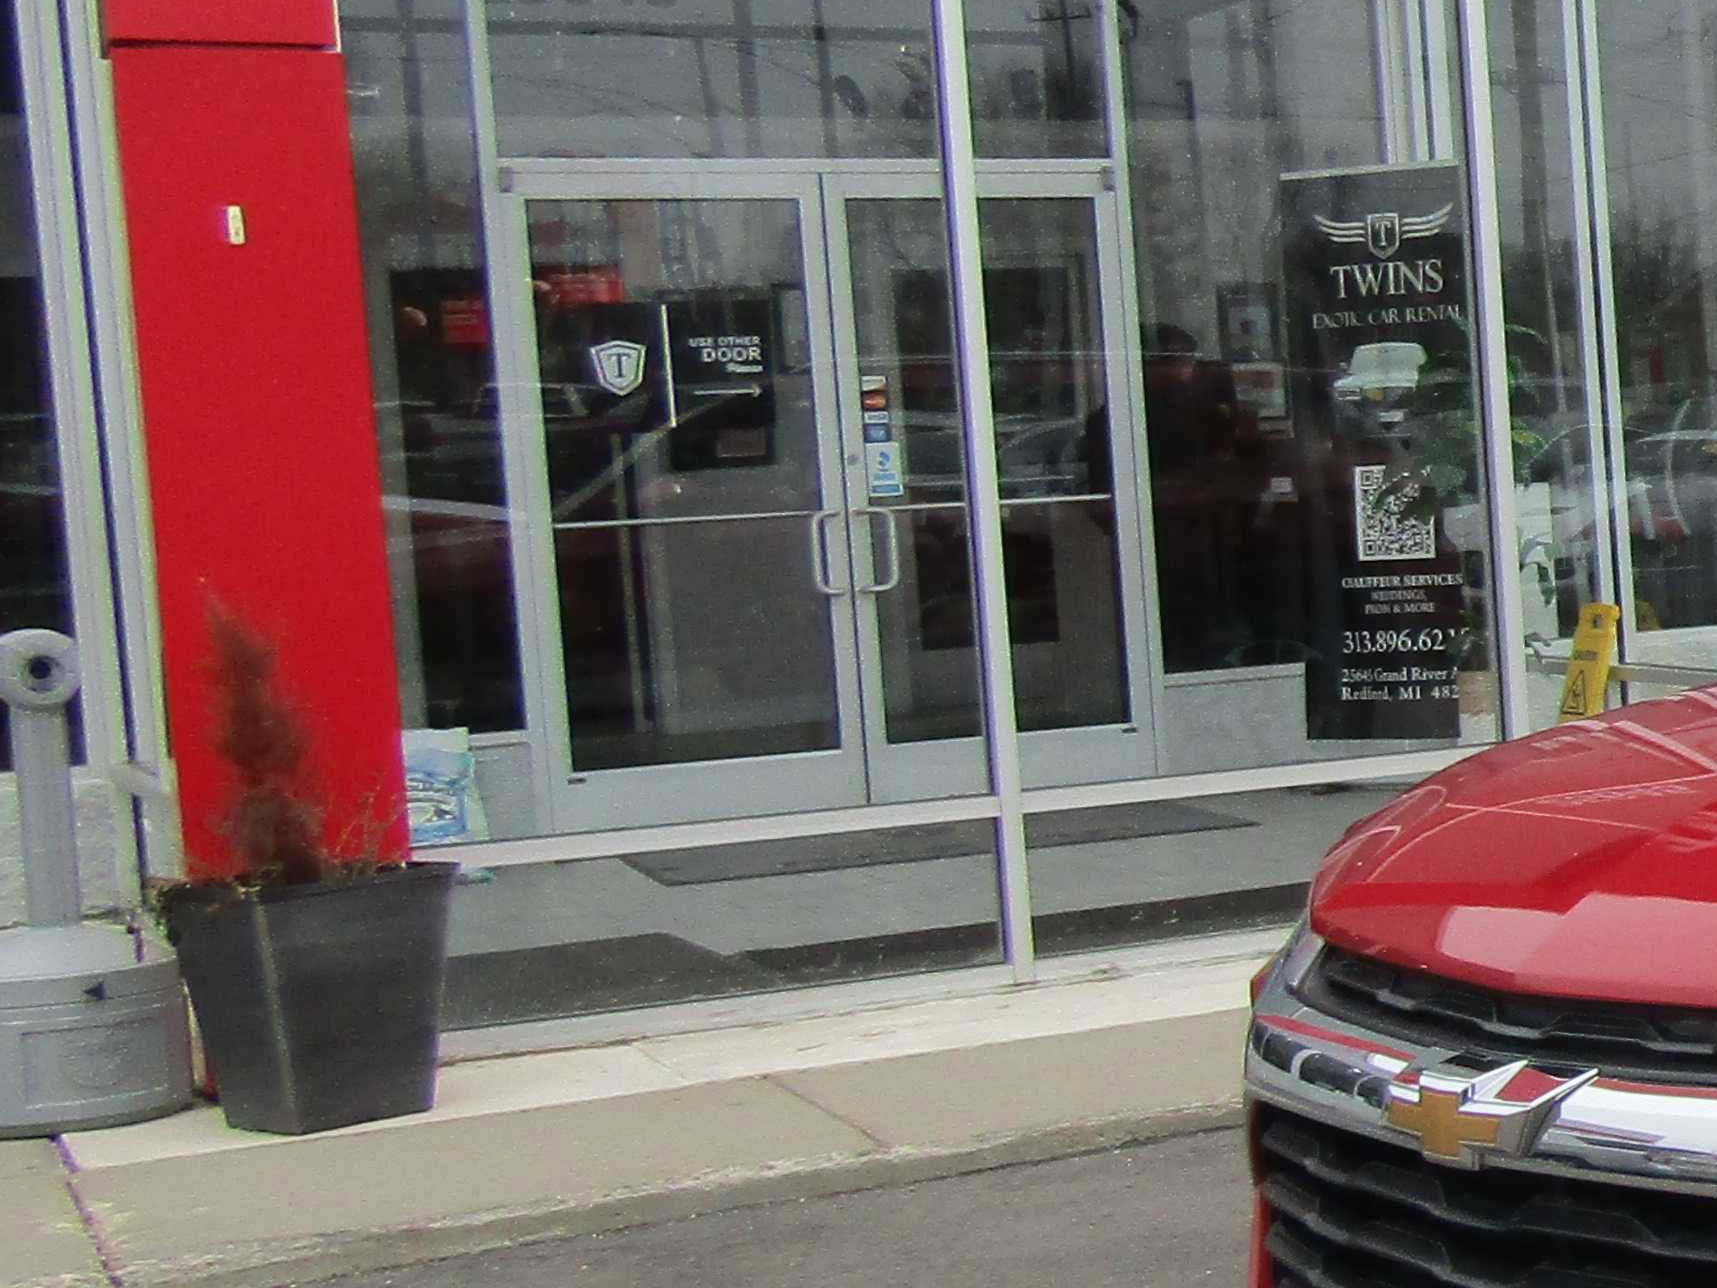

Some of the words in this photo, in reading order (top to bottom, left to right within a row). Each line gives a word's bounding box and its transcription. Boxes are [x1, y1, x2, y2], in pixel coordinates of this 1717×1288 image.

[1330, 258, 1444, 299] TWINS
[1312, 312, 1363, 330] EXOTIC
[1368, 308, 1402, 326] CAR
[1406, 303, 1463, 323] RENTAL
[718, 335, 761, 346] OTHER
[703, 347, 762, 362] DOOR
[1403, 573, 1464, 587] SERVICES
[1342, 626, 1470, 654] 313.896.62
[1374, 667, 1407, 682] Grand
[1410, 666, 1447, 681] River
